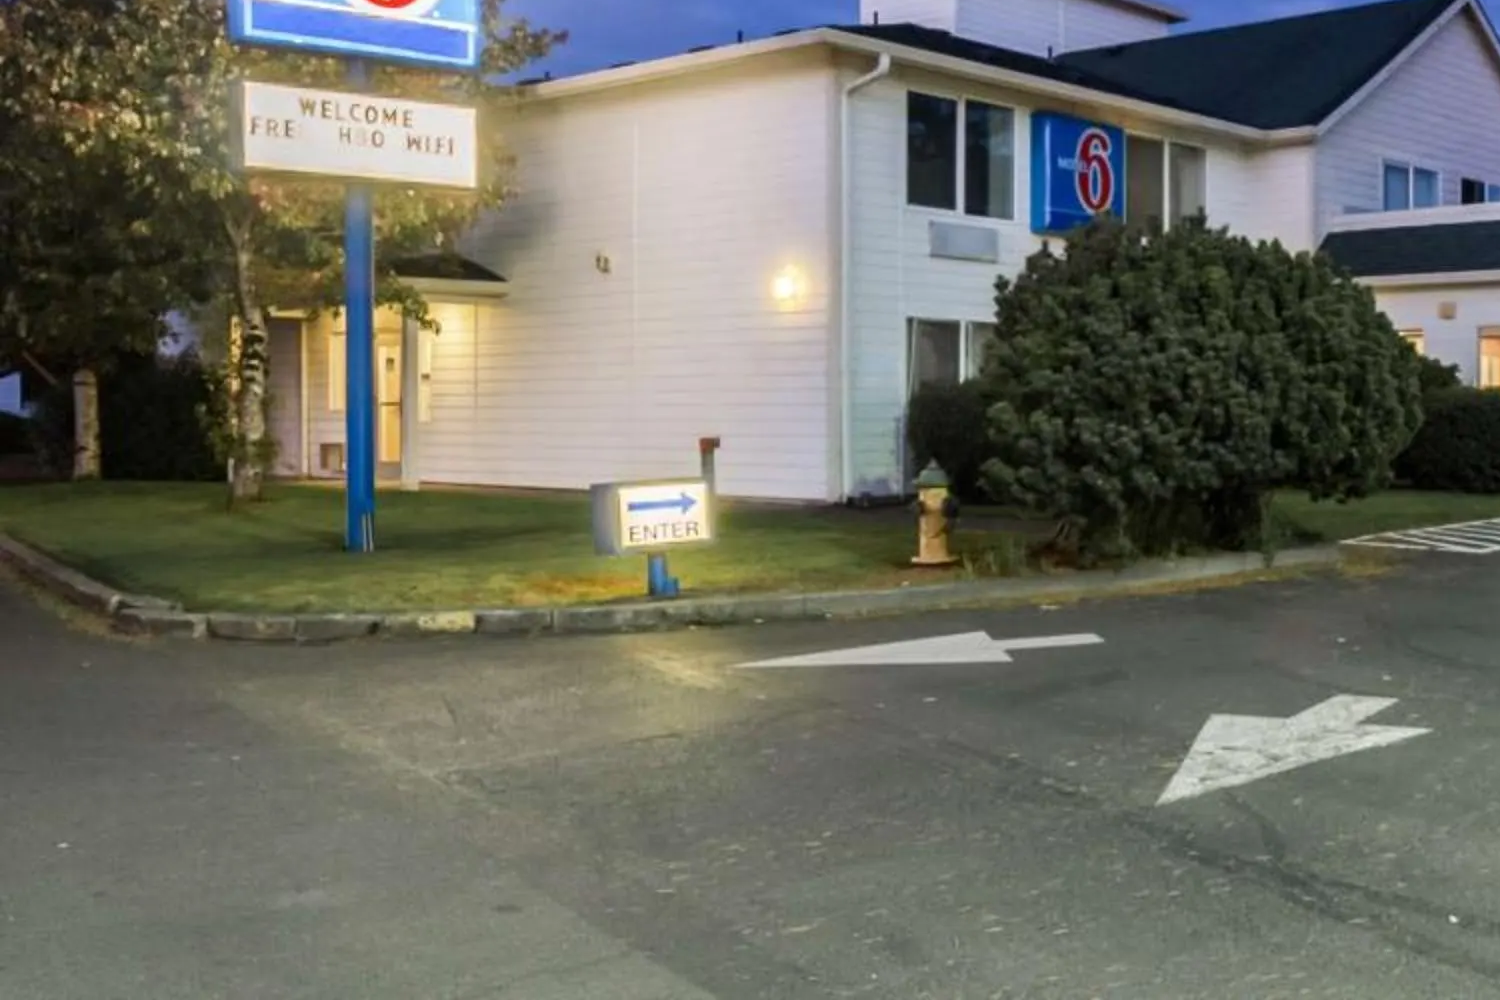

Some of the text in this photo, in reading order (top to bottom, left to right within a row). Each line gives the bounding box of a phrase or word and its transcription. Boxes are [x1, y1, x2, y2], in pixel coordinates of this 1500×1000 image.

[299, 97, 414, 128] WELCOME
[338, 126, 385, 148] HO
[406, 134, 454, 155] WIFI
[1077, 130, 1113, 212] 6
[628, 521, 699, 542] ENTER
